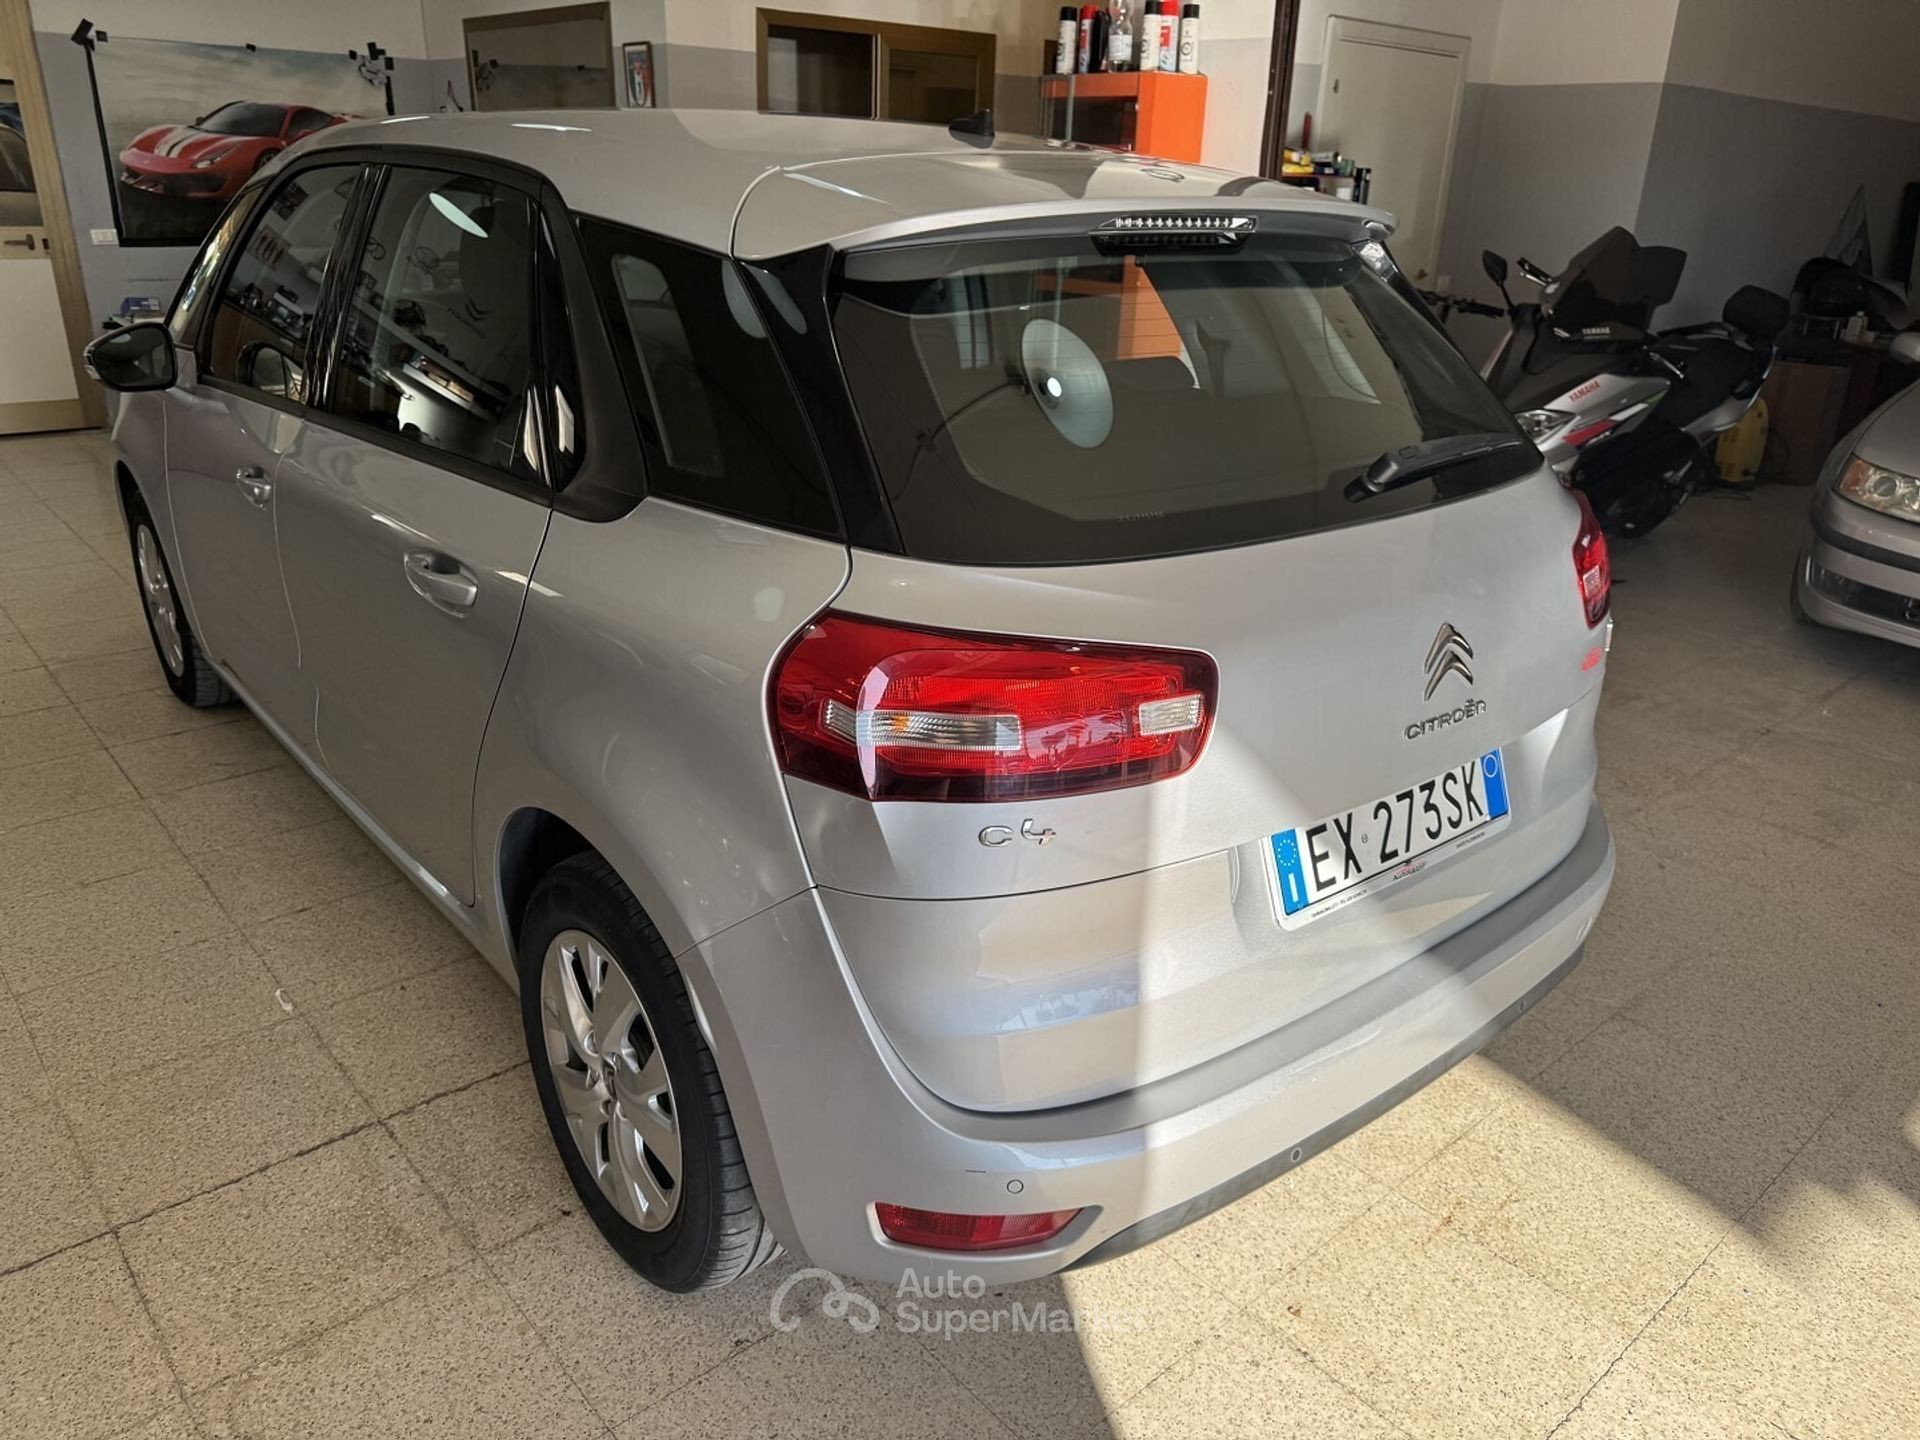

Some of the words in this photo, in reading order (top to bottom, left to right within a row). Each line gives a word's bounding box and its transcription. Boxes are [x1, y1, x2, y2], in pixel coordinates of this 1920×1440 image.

[1570, 381, 1601, 401] YAMAHA
[978, 818, 1056, 847] C4
[1306, 812, 1363, 892] EX
[1373, 760, 1485, 864] 273SK
